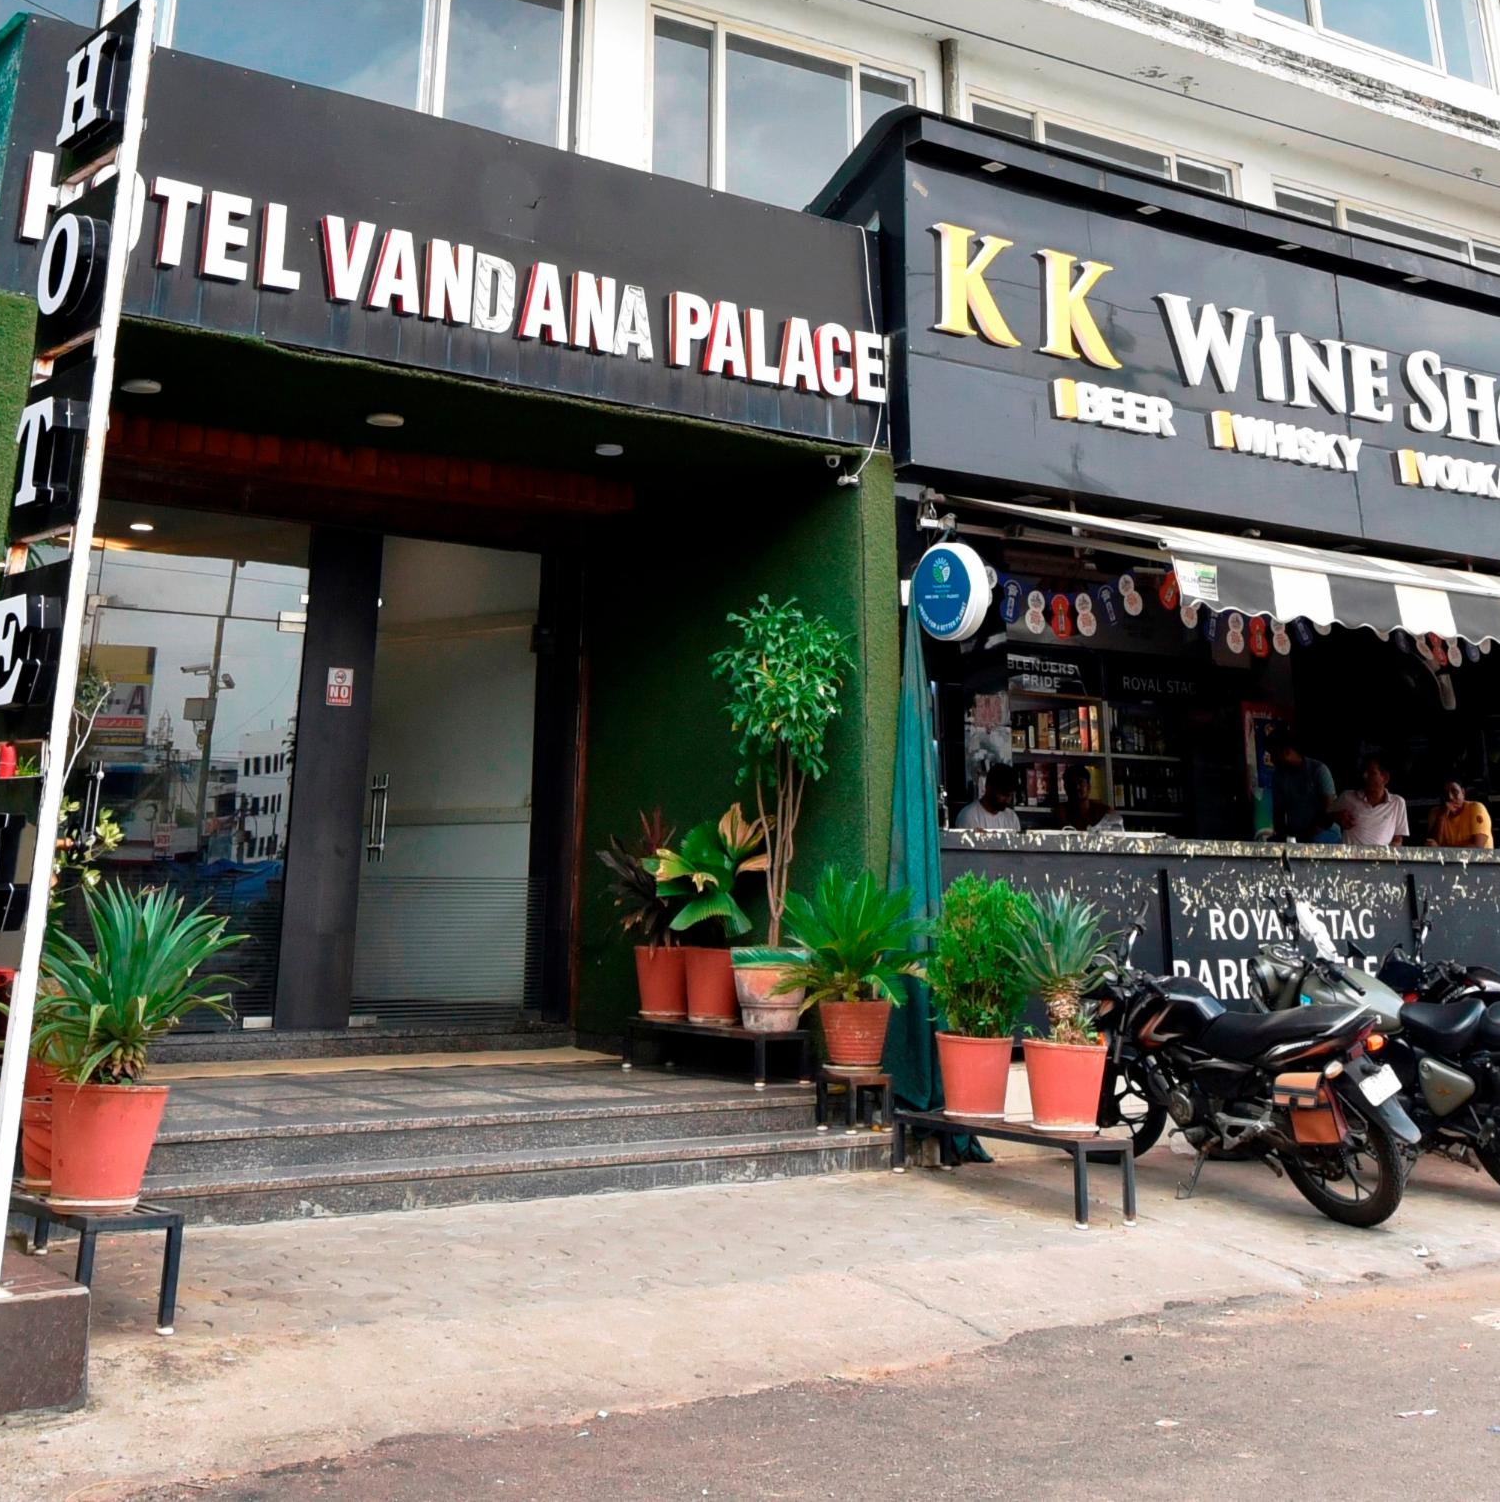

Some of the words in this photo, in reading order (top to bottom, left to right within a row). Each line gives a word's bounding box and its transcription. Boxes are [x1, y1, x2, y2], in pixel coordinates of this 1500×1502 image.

[321, 215, 654, 362] VANDANA
[669, 290, 886, 404] PALACE
[1074, 380, 1178, 438] BEER
[1228, 412, 1363, 472] WHISKY
[329, 686, 349, 699] NO
[1022, 673, 1061, 689] PRIDE
[1122, 675, 1163, 693] ROYAL
[1208, 908, 1294, 941] ROYA
